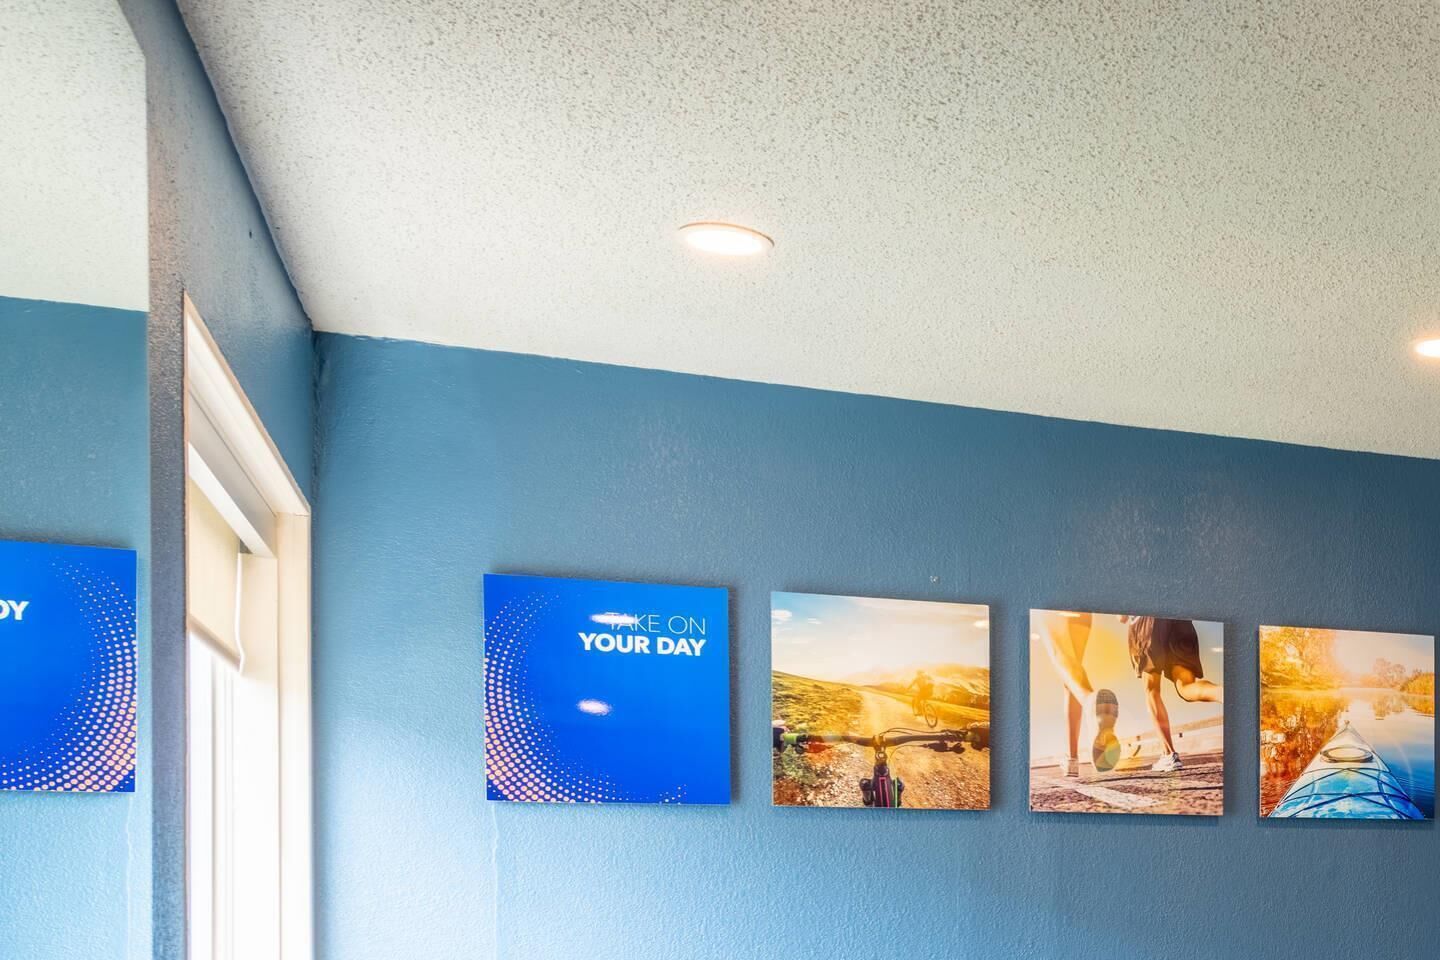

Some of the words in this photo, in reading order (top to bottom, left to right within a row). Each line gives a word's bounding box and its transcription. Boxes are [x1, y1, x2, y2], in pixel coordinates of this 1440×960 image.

[602, 611, 661, 632] TAKE
[667, 615, 706, 635] ON
[578, 632, 651, 654] YOUR
[656, 636, 707, 656] DAY
